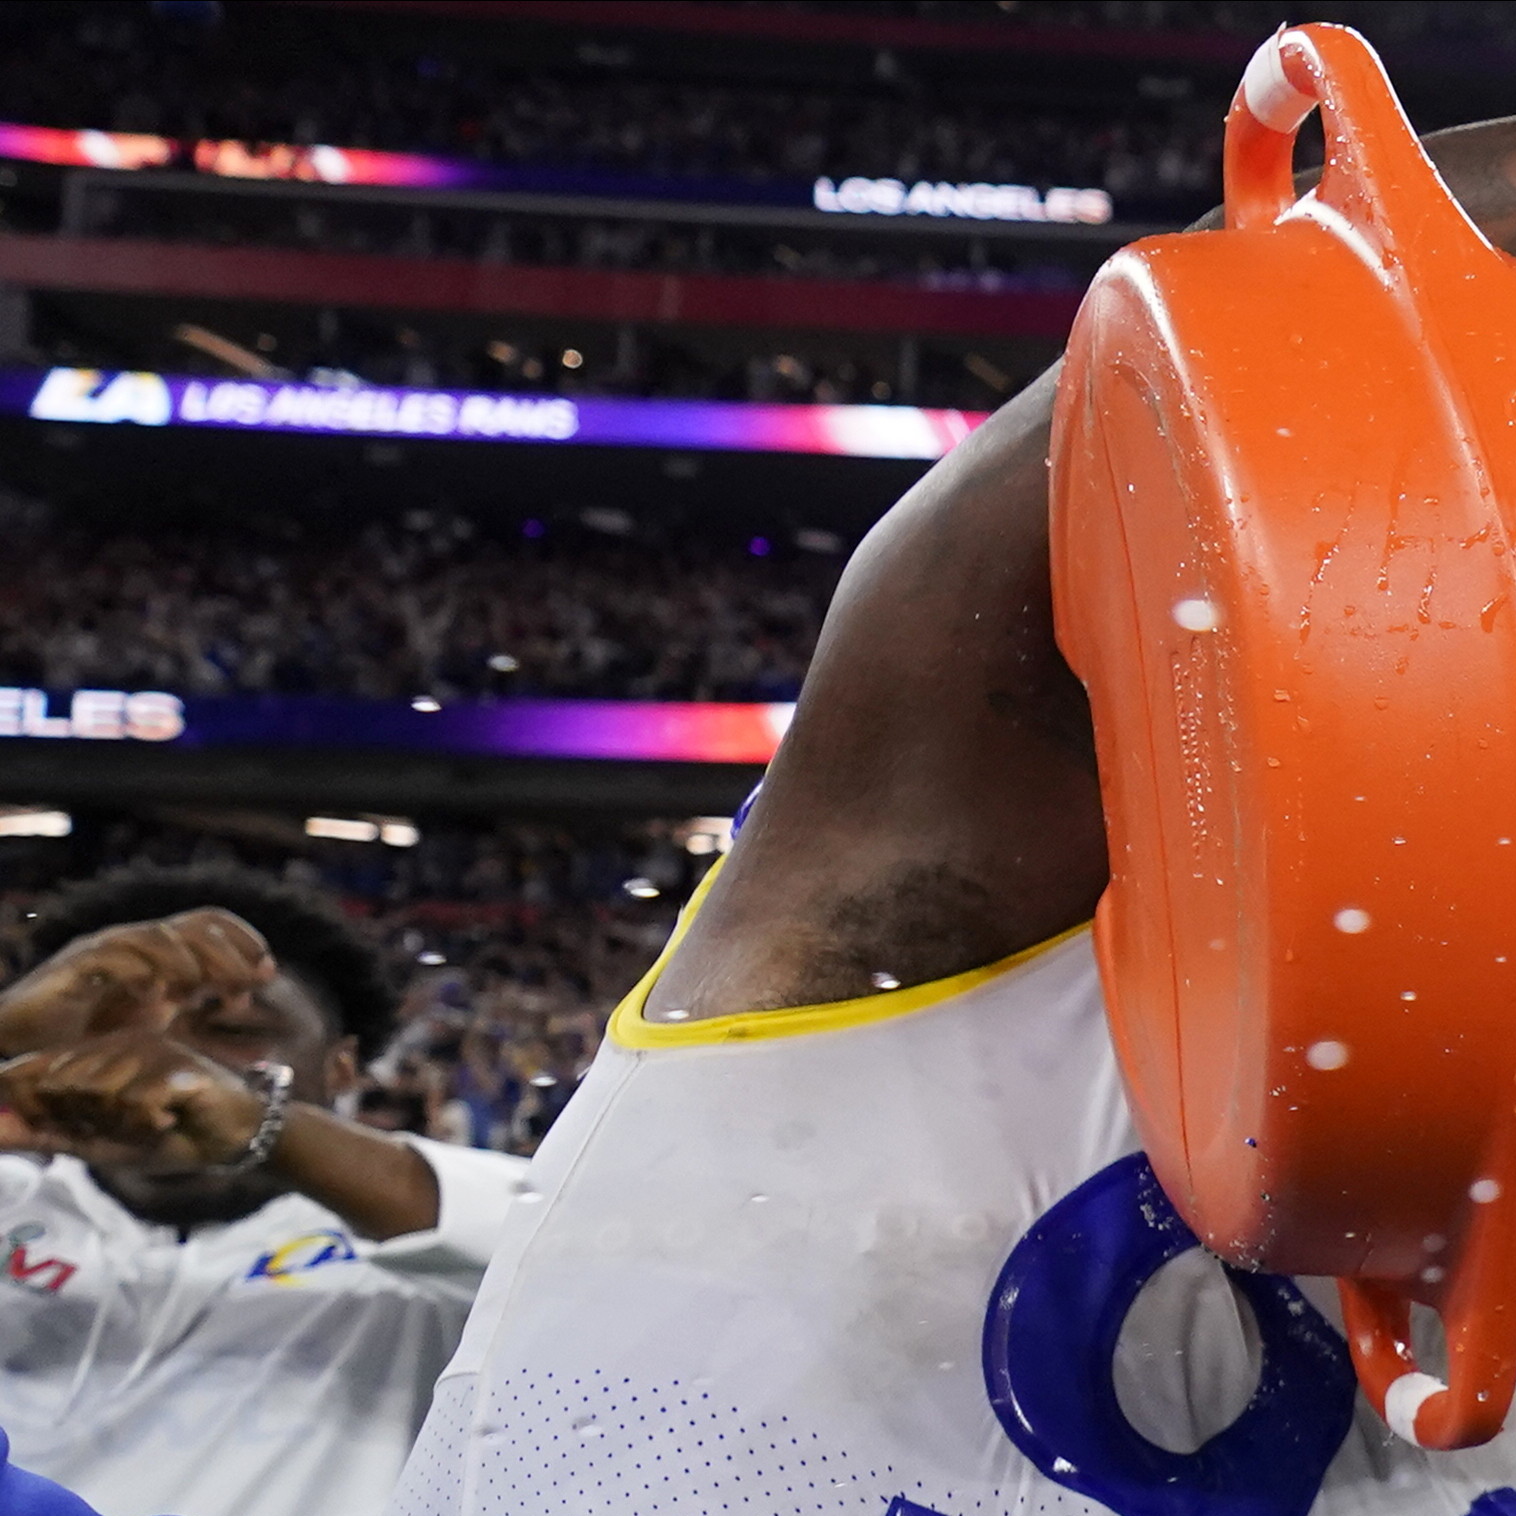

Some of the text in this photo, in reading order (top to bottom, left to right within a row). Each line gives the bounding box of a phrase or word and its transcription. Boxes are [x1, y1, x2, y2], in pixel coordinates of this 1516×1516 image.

[813, 176, 1112, 225] LOS ANGELES
[180, 382, 579, 440] LOS ANGELES RAMS
